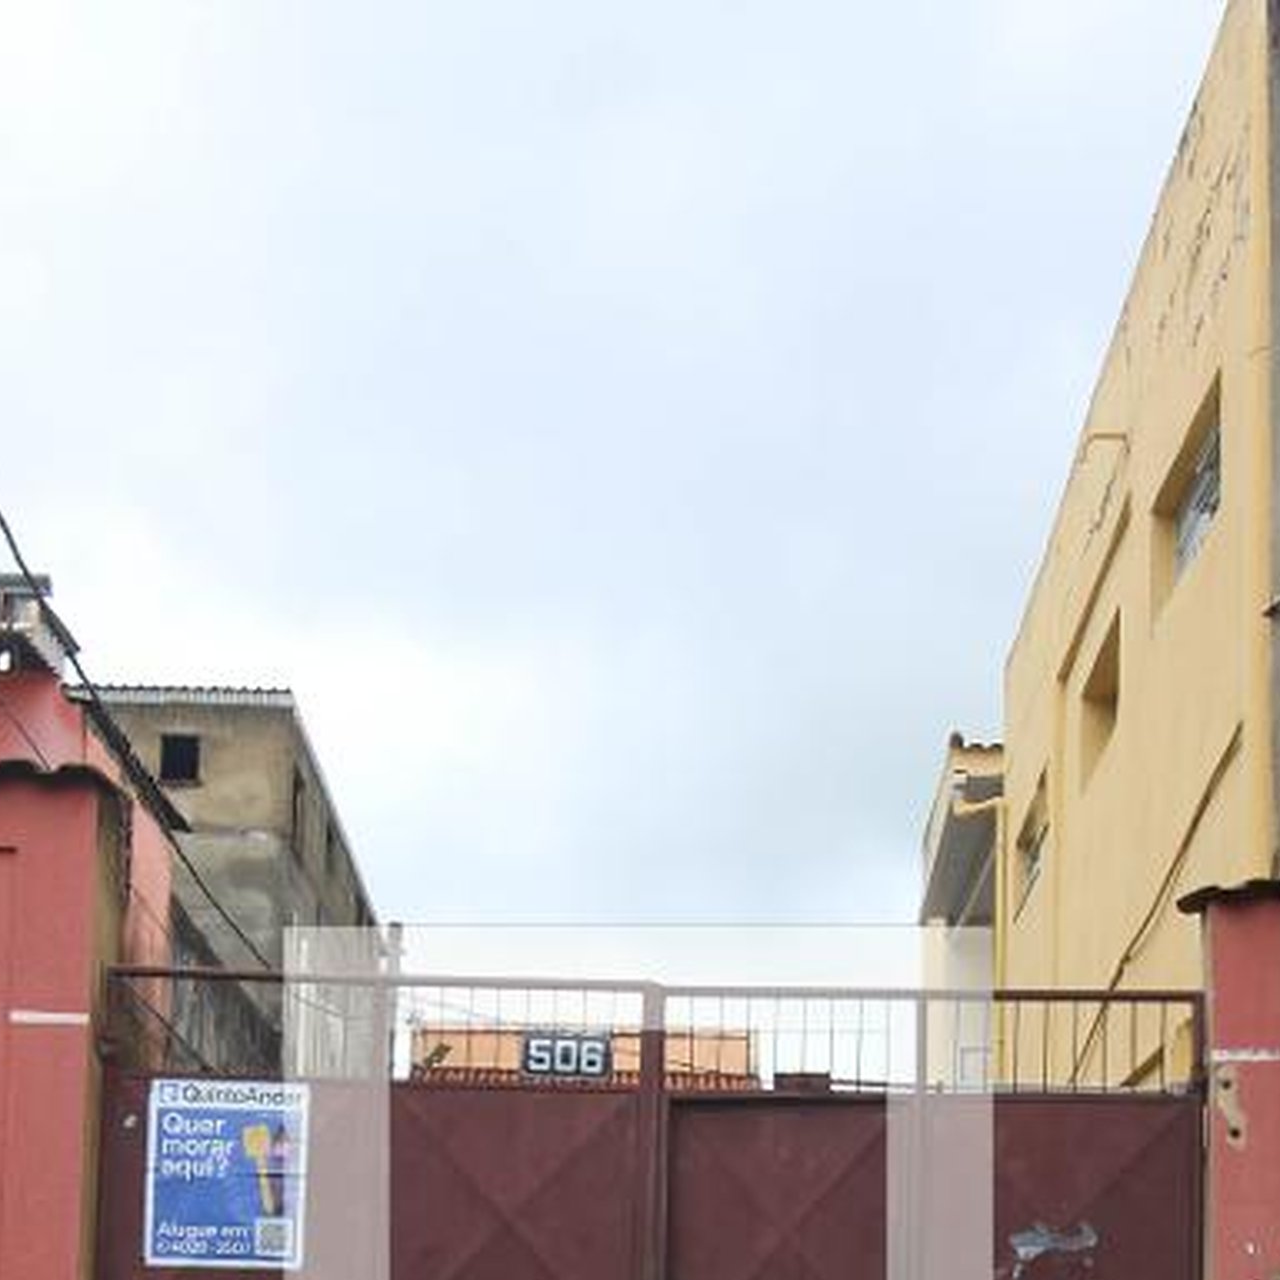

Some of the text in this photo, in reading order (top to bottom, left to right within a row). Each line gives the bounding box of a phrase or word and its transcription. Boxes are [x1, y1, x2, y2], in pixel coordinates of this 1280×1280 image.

[528, 1038, 605, 1075] 506
[161, 1112, 227, 1136] Quer
[162, 1138, 234, 1157] morar
[161, 1156, 230, 1182] aqui?
